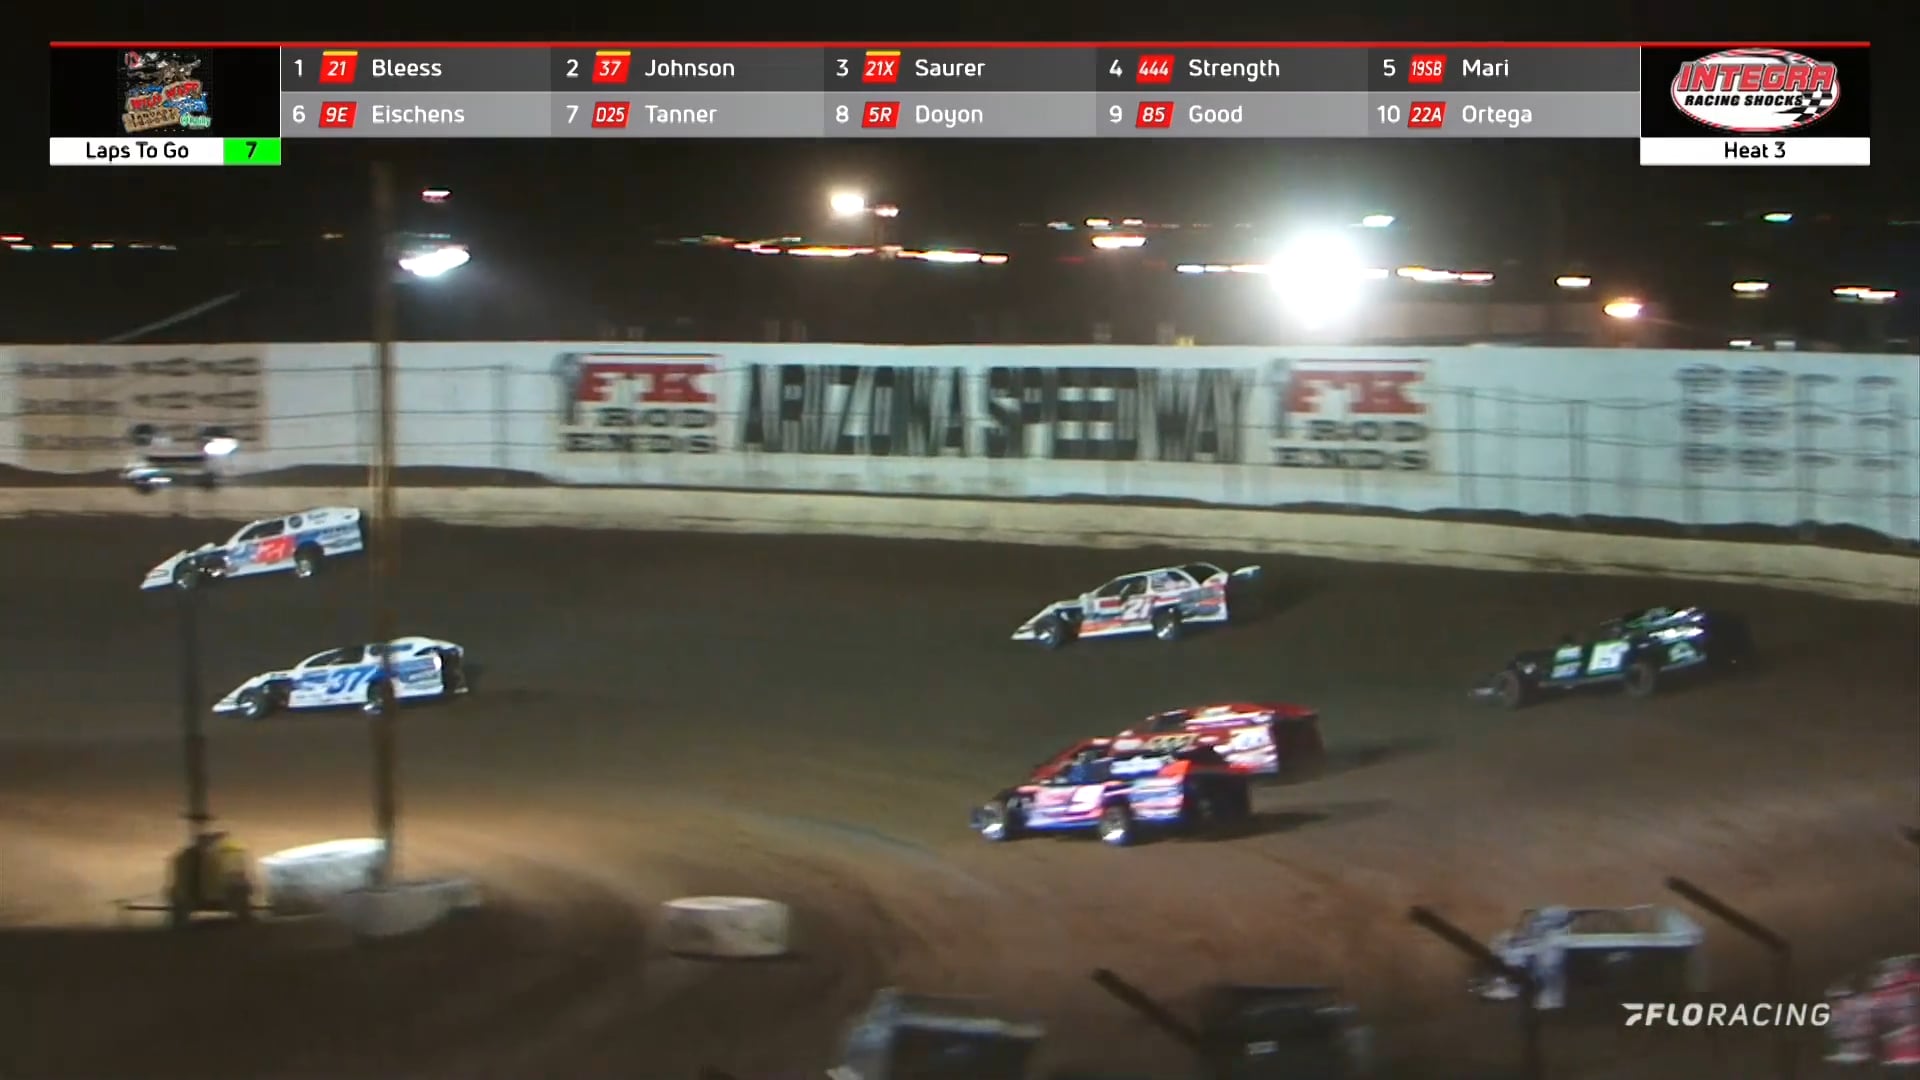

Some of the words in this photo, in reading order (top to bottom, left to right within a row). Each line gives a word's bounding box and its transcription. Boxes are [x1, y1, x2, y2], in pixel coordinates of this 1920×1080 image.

[744, 364, 966, 457] ARIZONA
[983, 365, 1250, 464] SPEEDWAY
[326, 664, 376, 694] 37
